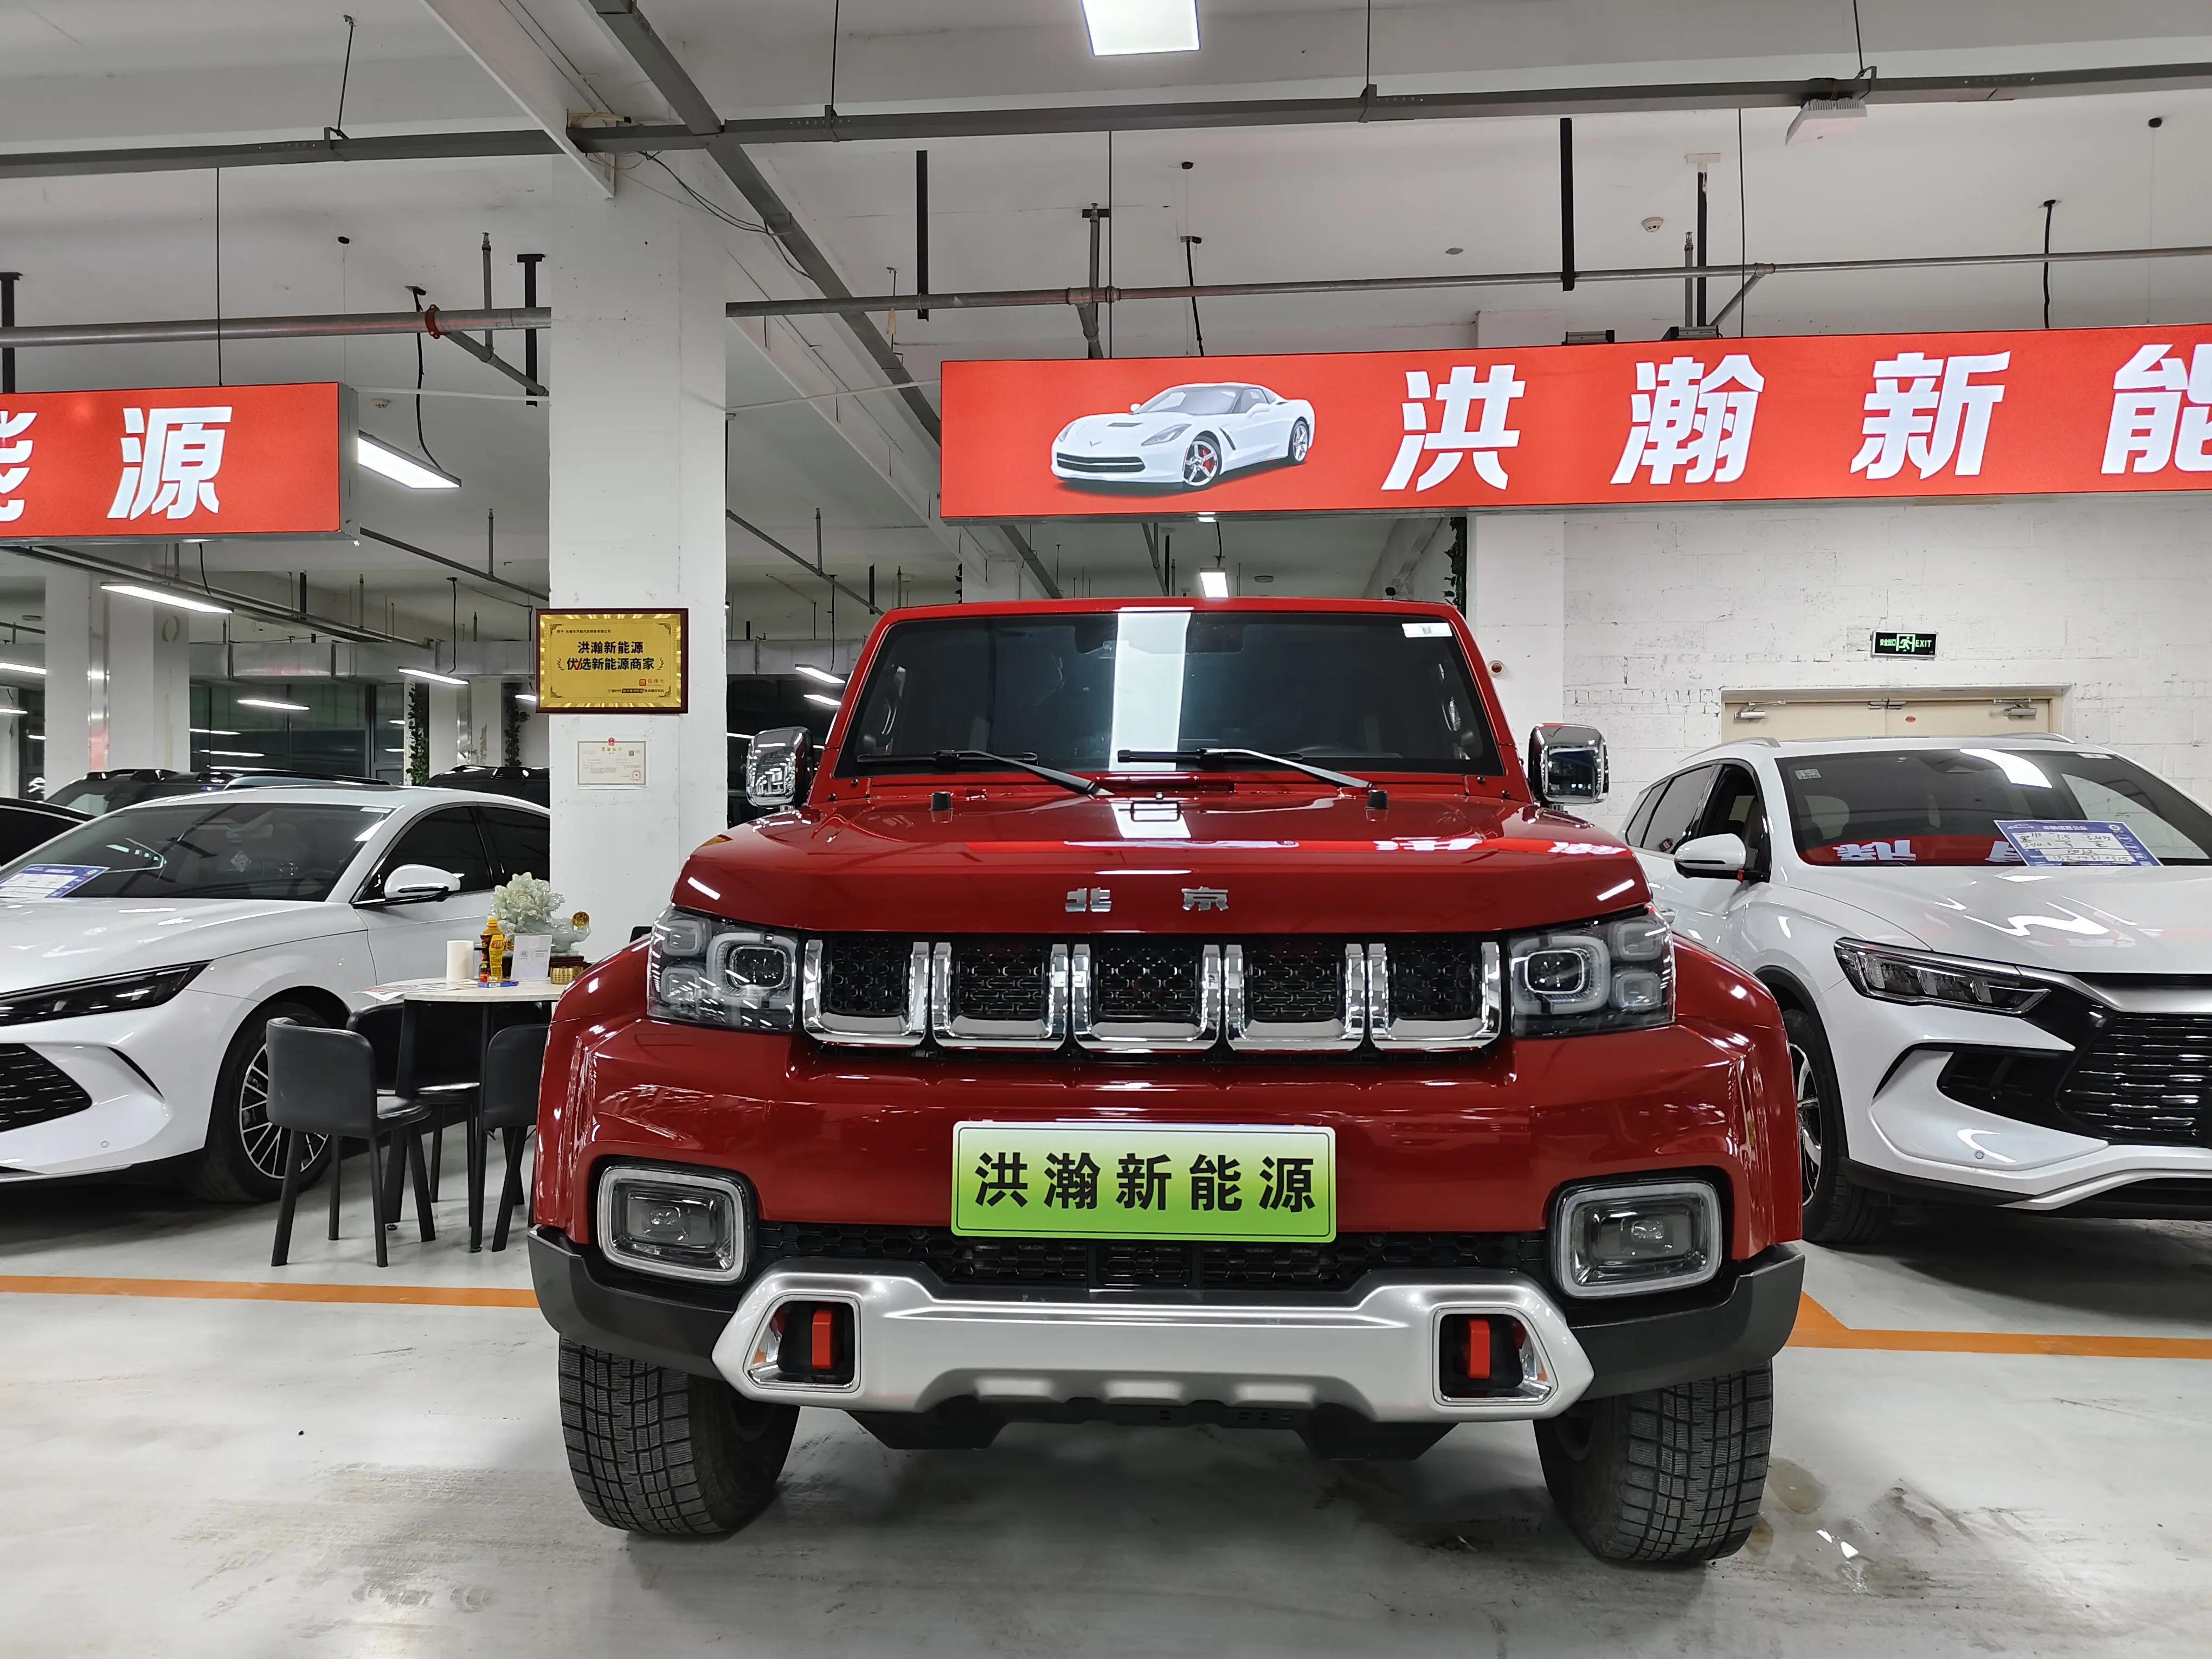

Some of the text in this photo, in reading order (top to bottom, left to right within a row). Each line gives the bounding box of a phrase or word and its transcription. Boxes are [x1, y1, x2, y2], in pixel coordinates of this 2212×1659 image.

[577, 641, 644, 654] 洪瀚新能源
[1915, 639, 1932, 648] EXIT
[975, 1152, 1316, 1213] 洪瀚新能源
